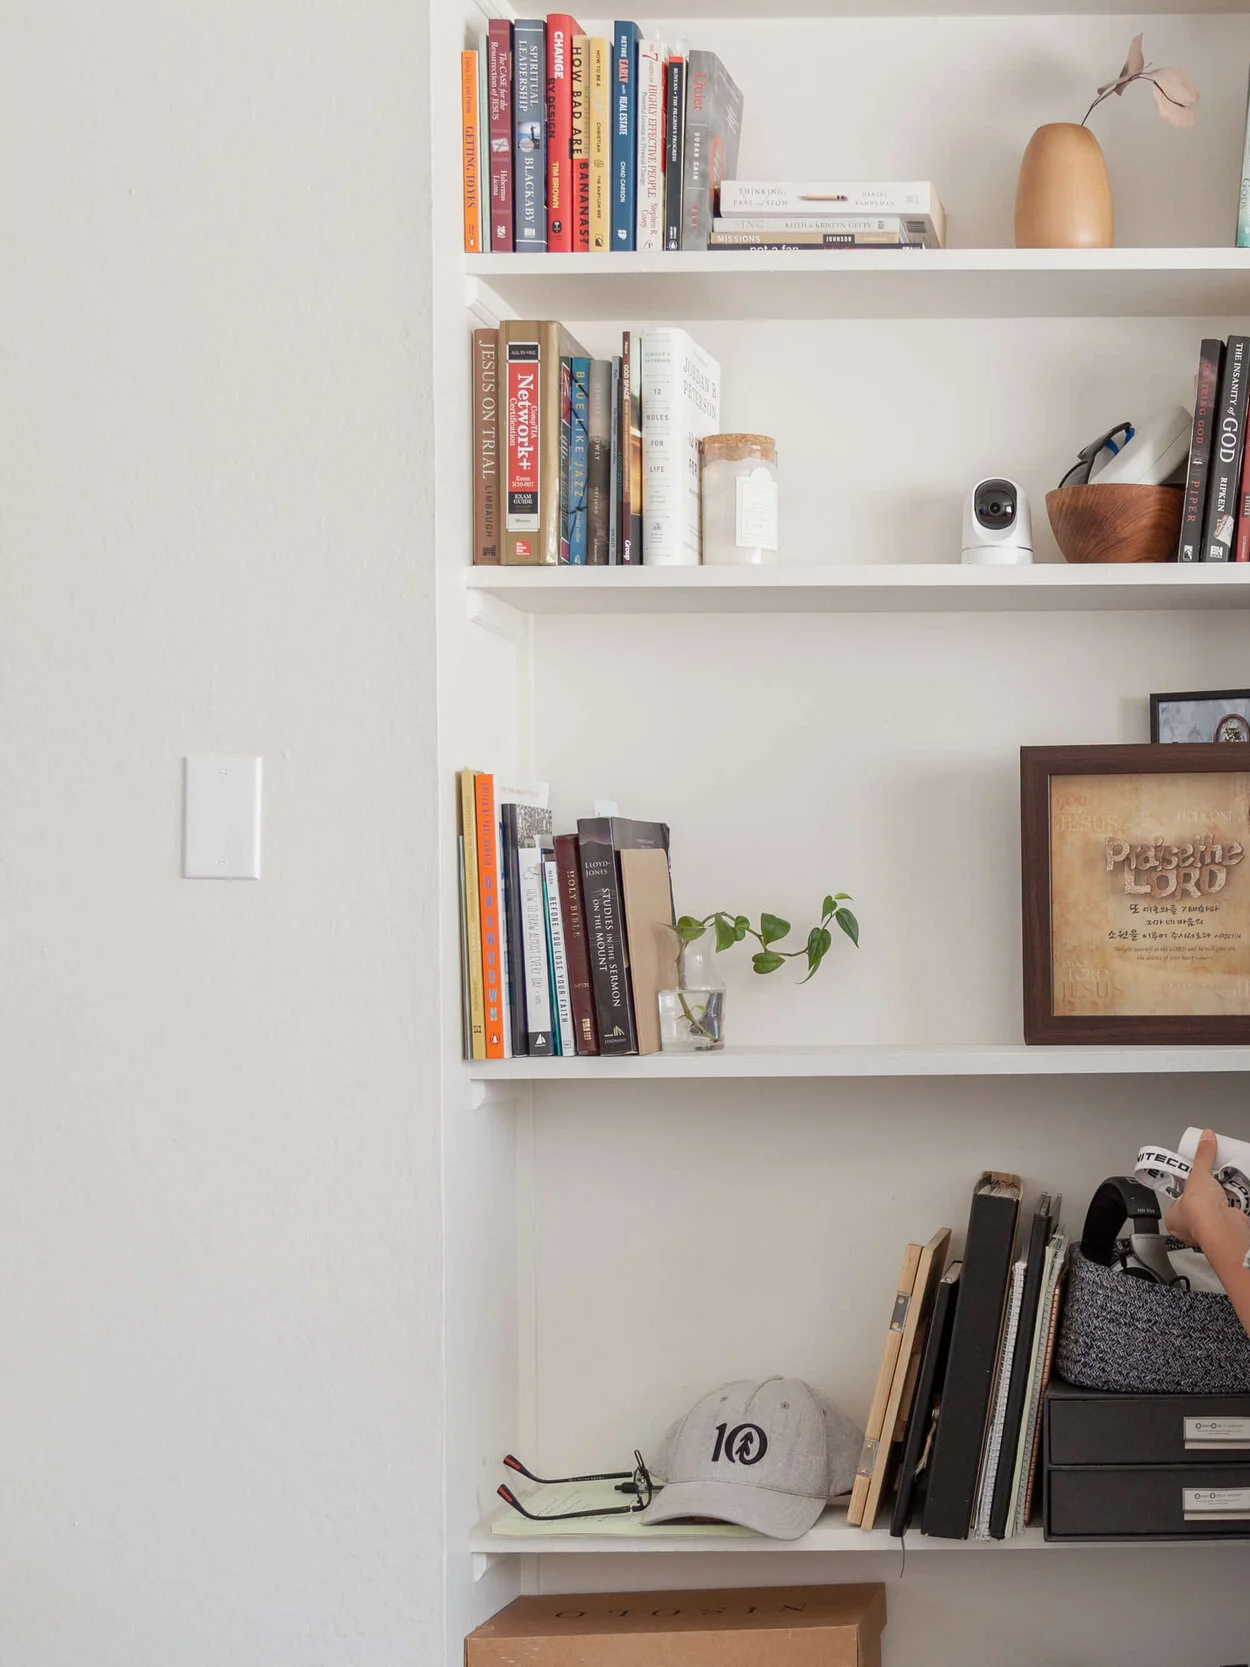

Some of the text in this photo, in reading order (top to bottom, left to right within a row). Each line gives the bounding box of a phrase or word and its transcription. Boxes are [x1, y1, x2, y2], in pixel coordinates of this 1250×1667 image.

[519, 40, 529, 112] LEADERSHIP
[529, 45, 539, 107] SPIRITUAL
[554, 31, 564, 79] CHANGE
[491, 41, 500, 121] Resurrection of JESUS
[499, 52, 508, 111] The CASE for the
[571, 47, 583, 155] HOW BAD ARE
[618, 35, 629, 135] RETIRE EARLY REAL ESTATE
[692, 72, 709, 111] Quiet
[547, 78, 556, 139] BY DESIGN
[642, 52, 658, 198] 7 HIGHLY EFFECTIVE PEOPLE
[465, 126, 477, 208] GETTING TO YES
[692, 133, 701, 181] SUSAN CAIN
[525, 157, 535, 223] BLACKABY
[552, 161, 560, 209] TIM BROWN
[579, 162, 589, 244] BANANAS?
[738, 188, 786, 196] THINKING,
[640, 209, 649, 228] Covey
[717, 235, 761, 243] MISSIONS
[826, 235, 852, 243] JOHNSON
[479, 340, 495, 479] JESUS ON TRIAL
[654, 388, 662, 396] 12
[683, 379, 717, 421] PETERSON
[1195, 362, 1212, 445] DESIRING GOD
[1219, 342, 1244, 463] THE INSANITY of GOD
[508, 397, 518, 446] Certification
[517, 373, 534, 470] Network+
[530, 405, 538, 439] CompTIA
[573, 371, 585, 497] BLUE LIKE JAZZ
[484, 485, 493, 538] LIMBAUGH
[1187, 480, 1200, 523] PIPER
[1217, 476, 1228, 512] RIPKEN
[623, 540, 632, 560] Group
[481, 783, 492, 867] EDITED BY PAUL HAWKEN
[527, 888, 538, 902] HOW
[584, 869, 608, 878] JONES
[1122, 863, 1228, 901] LORD
[528, 904, 538, 912] TO
[529, 913, 539, 930] DRAW
[566, 870, 581, 938] HOLY BIBLE
[1128, 903, 1140, 914] 또
[484, 875, 498, 1021] DRAWDOWN
[529, 931, 541, 953] ALMOST
[592, 899, 608, 972] ON THE MOUNT
[601, 887, 621, 1008] STUDIES IN THE SERMON
[1107, 928, 1139, 942] 소원을
[530, 954, 542, 977] EVERY
[531, 978, 542, 990] DAY
[549, 896, 569, 1024] BEFORE YOU LOSE YOUR FAITH
[711, 1422, 768, 1466] 10
